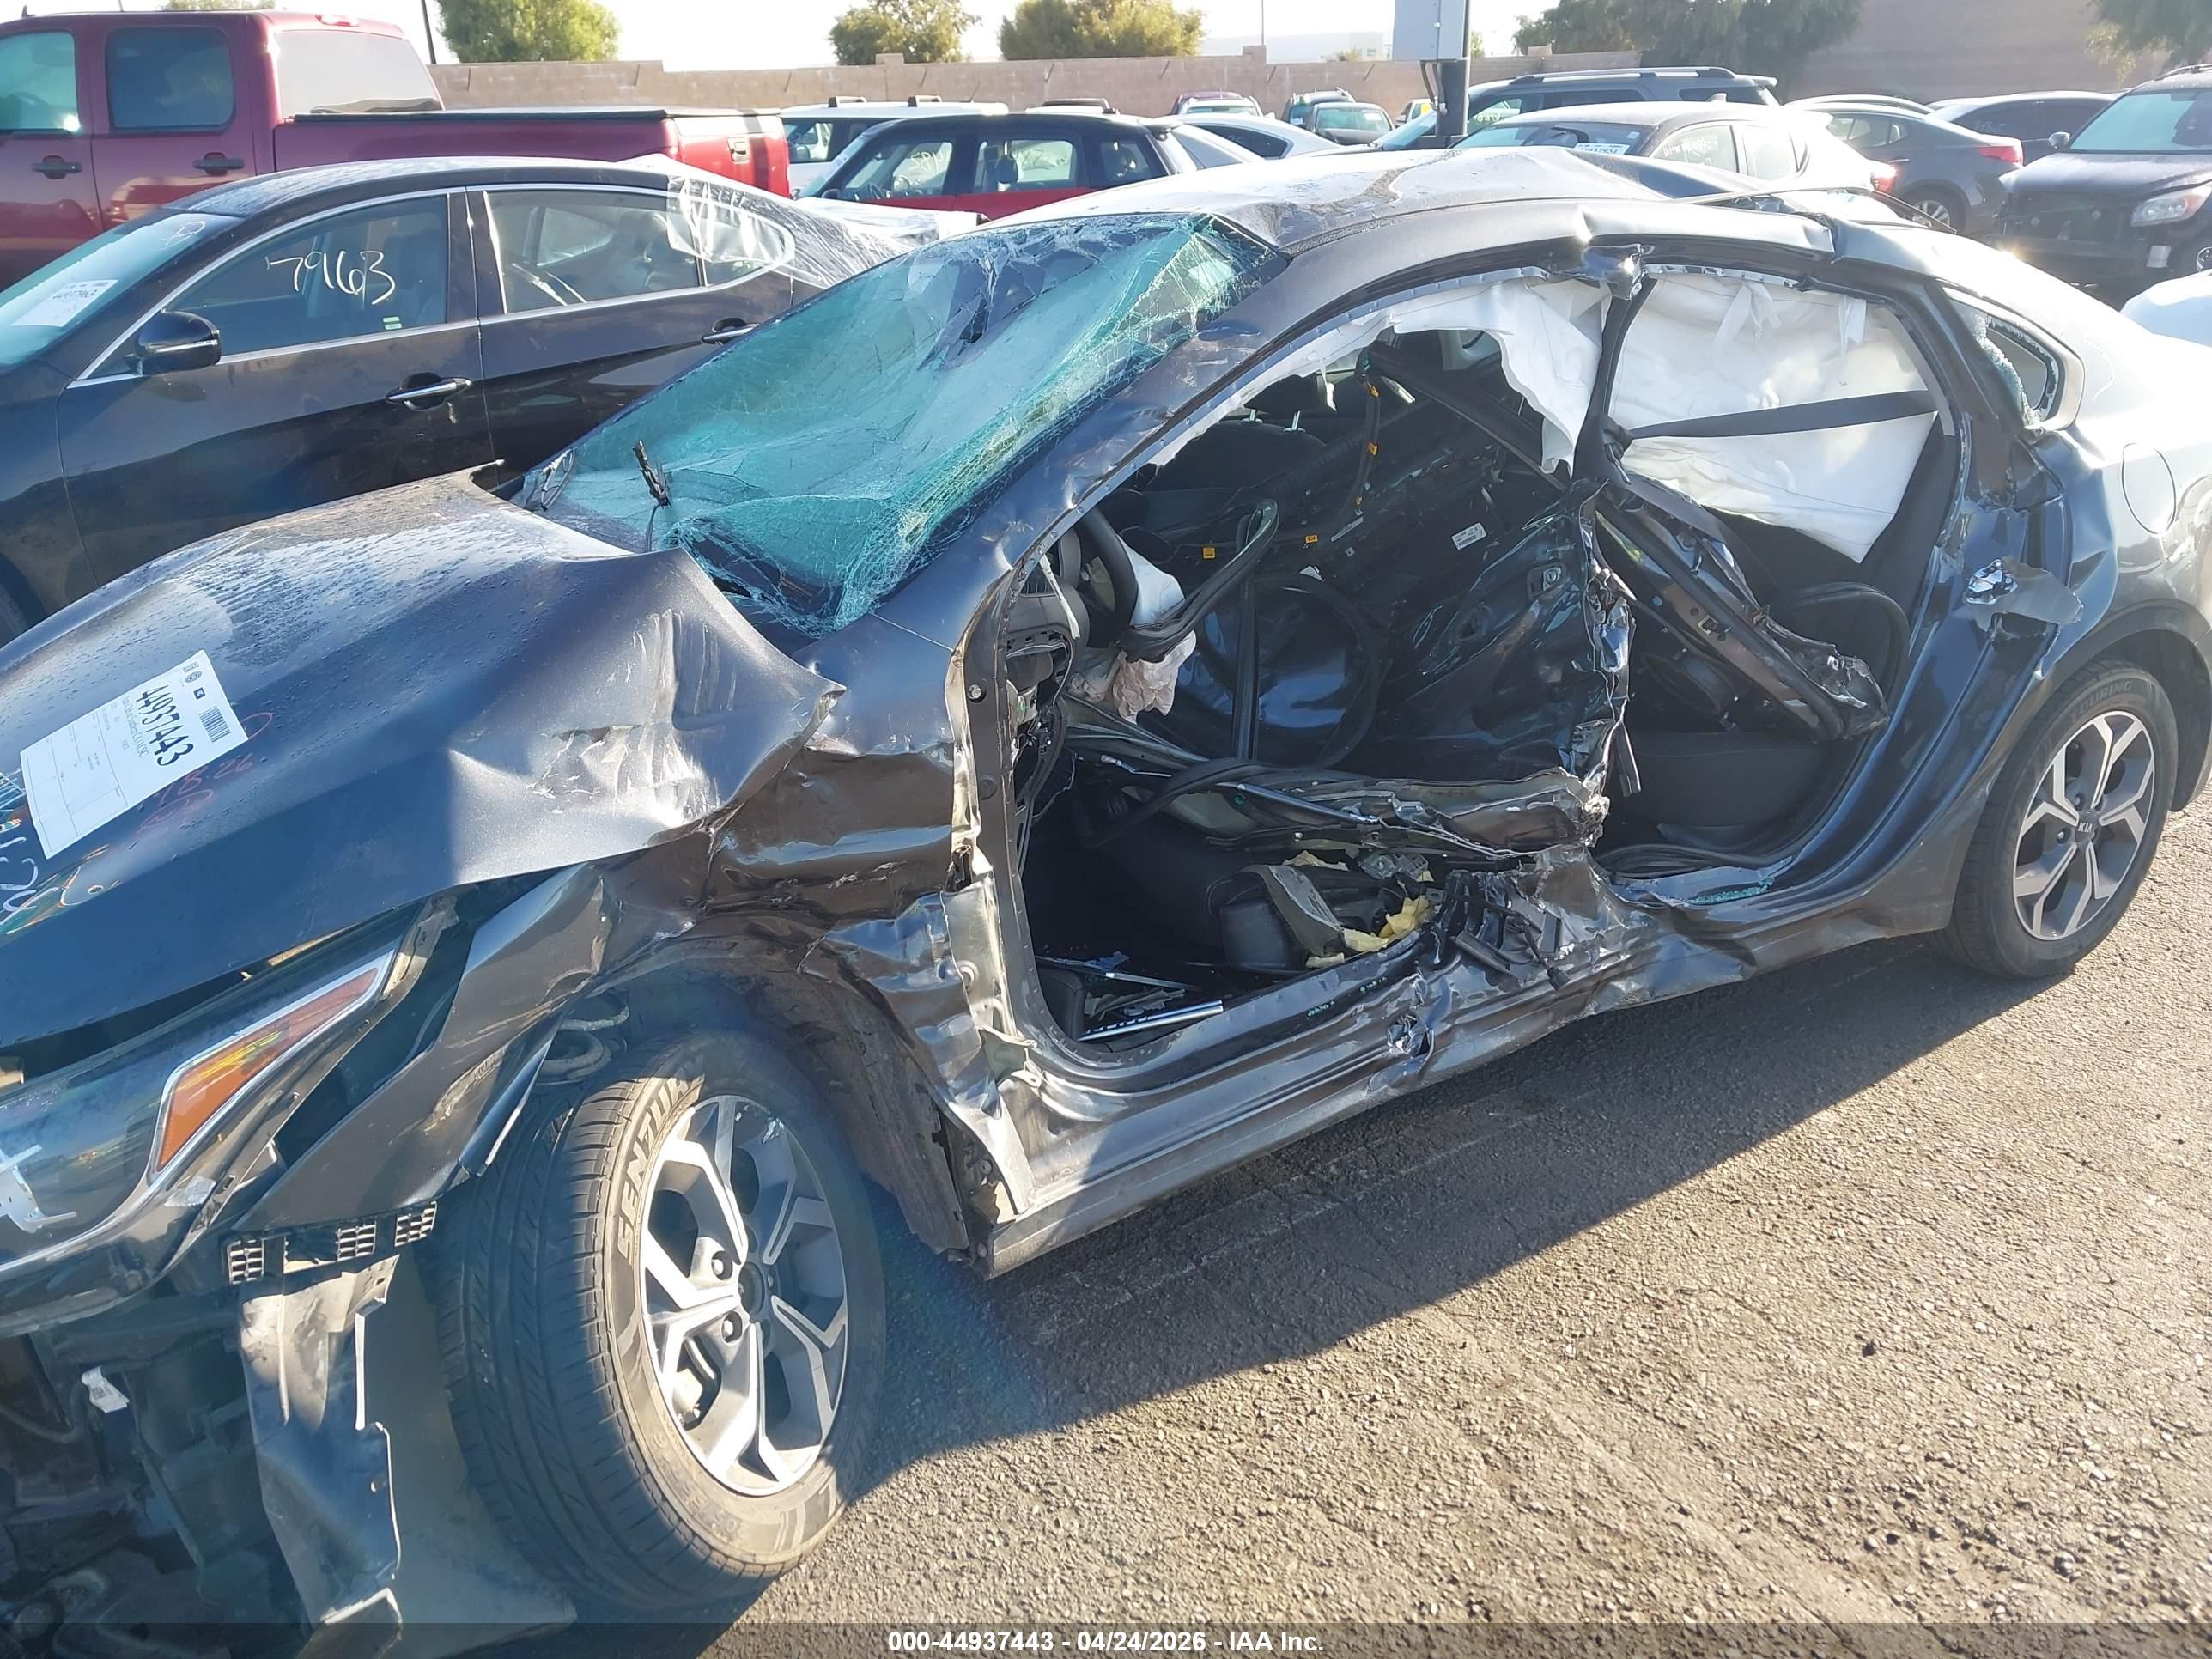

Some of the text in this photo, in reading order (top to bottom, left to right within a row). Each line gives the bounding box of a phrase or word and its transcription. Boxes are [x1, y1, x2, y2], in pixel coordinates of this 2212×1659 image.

[265, 250, 396, 305] 7963
[137, 684, 195, 766] 44937443
[2077, 821, 2093, 833] KIA
